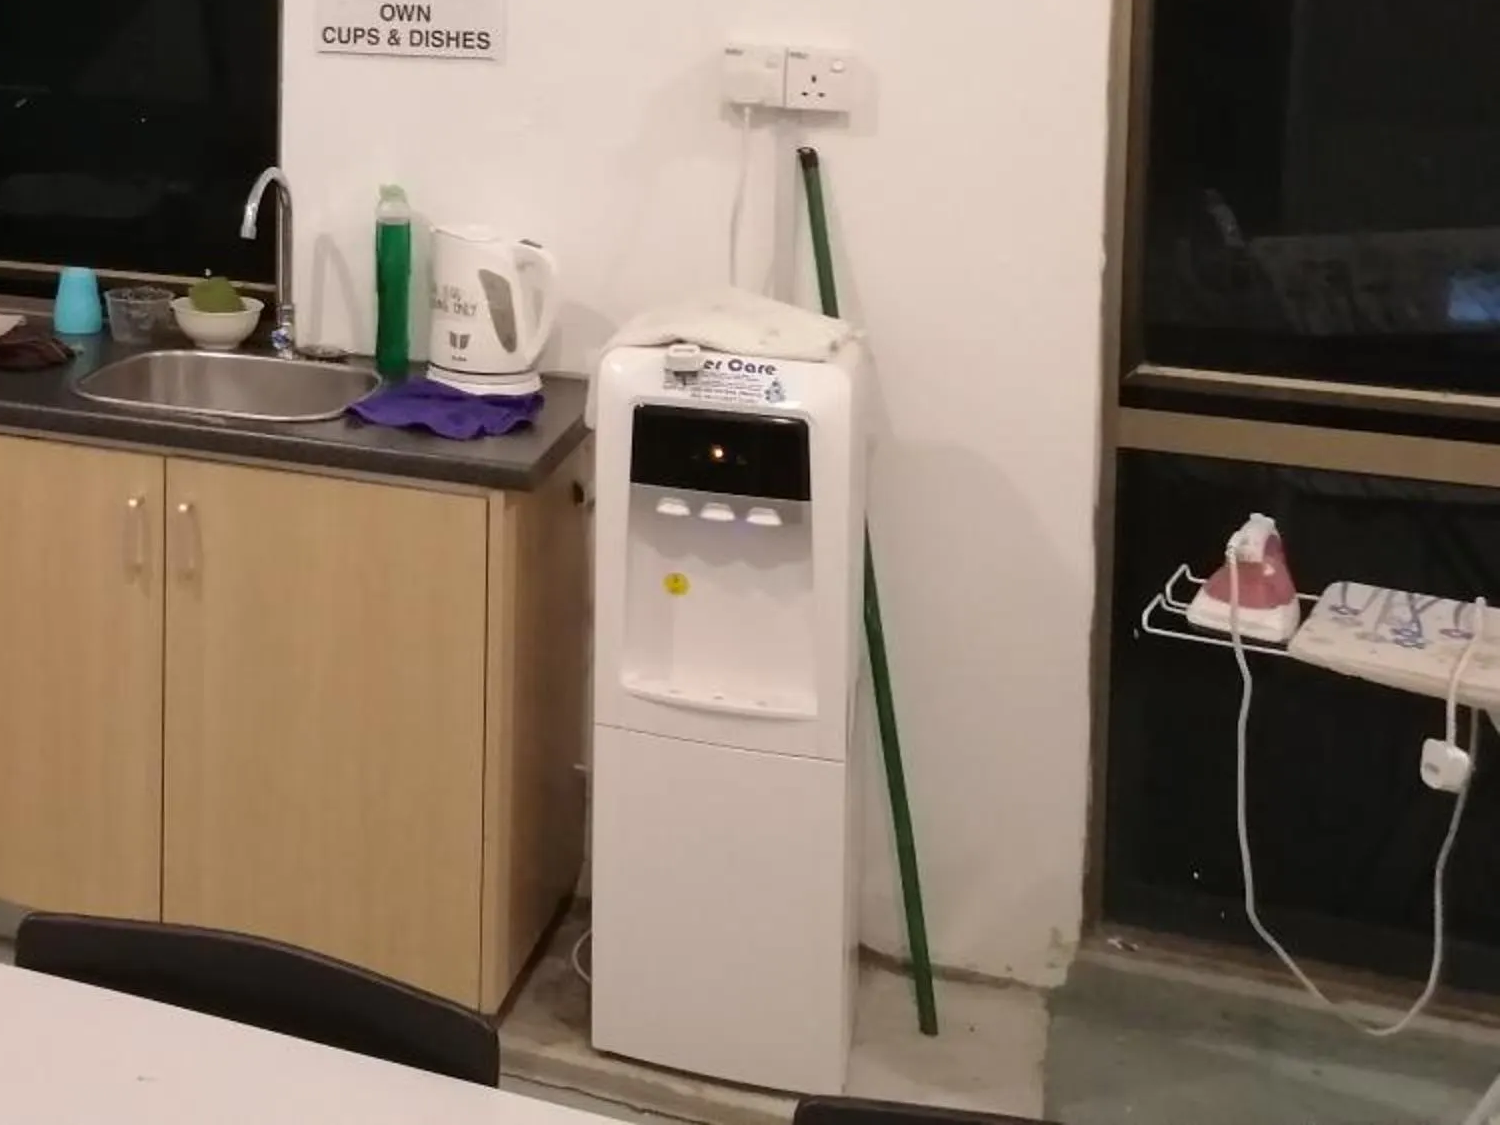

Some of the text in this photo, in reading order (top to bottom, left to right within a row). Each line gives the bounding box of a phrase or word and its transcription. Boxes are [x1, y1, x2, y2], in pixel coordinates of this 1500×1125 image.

[379, 3, 432, 23] OWN
[322, 26, 491, 50] CUPS & DISHES
[727, 358, 777, 375] Care
